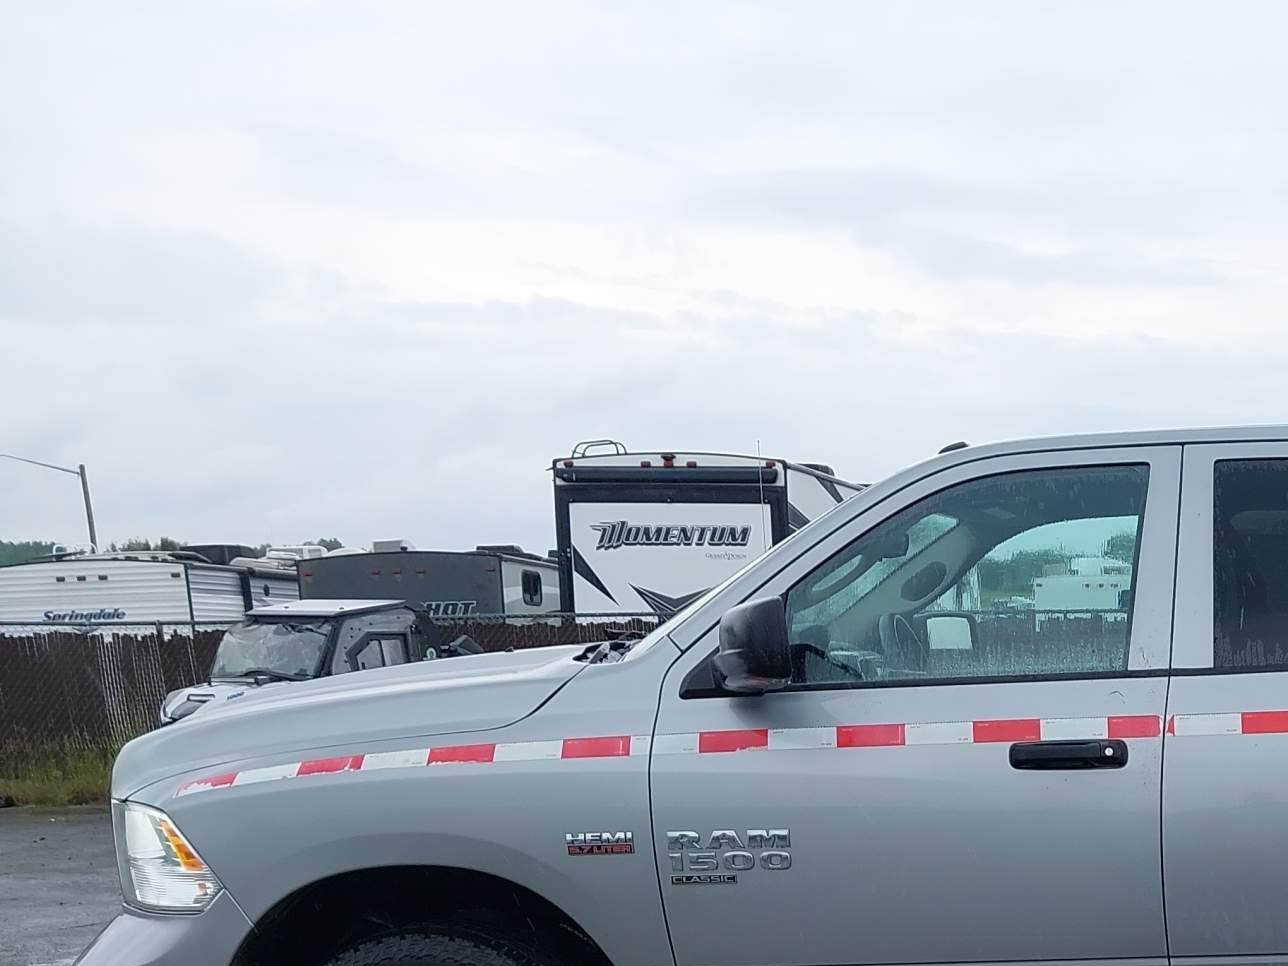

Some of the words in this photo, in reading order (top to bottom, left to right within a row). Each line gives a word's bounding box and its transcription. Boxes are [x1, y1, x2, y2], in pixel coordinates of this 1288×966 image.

[590, 520, 751, 550] MOMENTUM
[43, 608, 127, 624] Springdale
[565, 831, 633, 844] HEMI
[666, 829, 791, 850] RAM
[668, 851, 792, 872] 1500
[672, 875, 737, 884] CLASSIC
